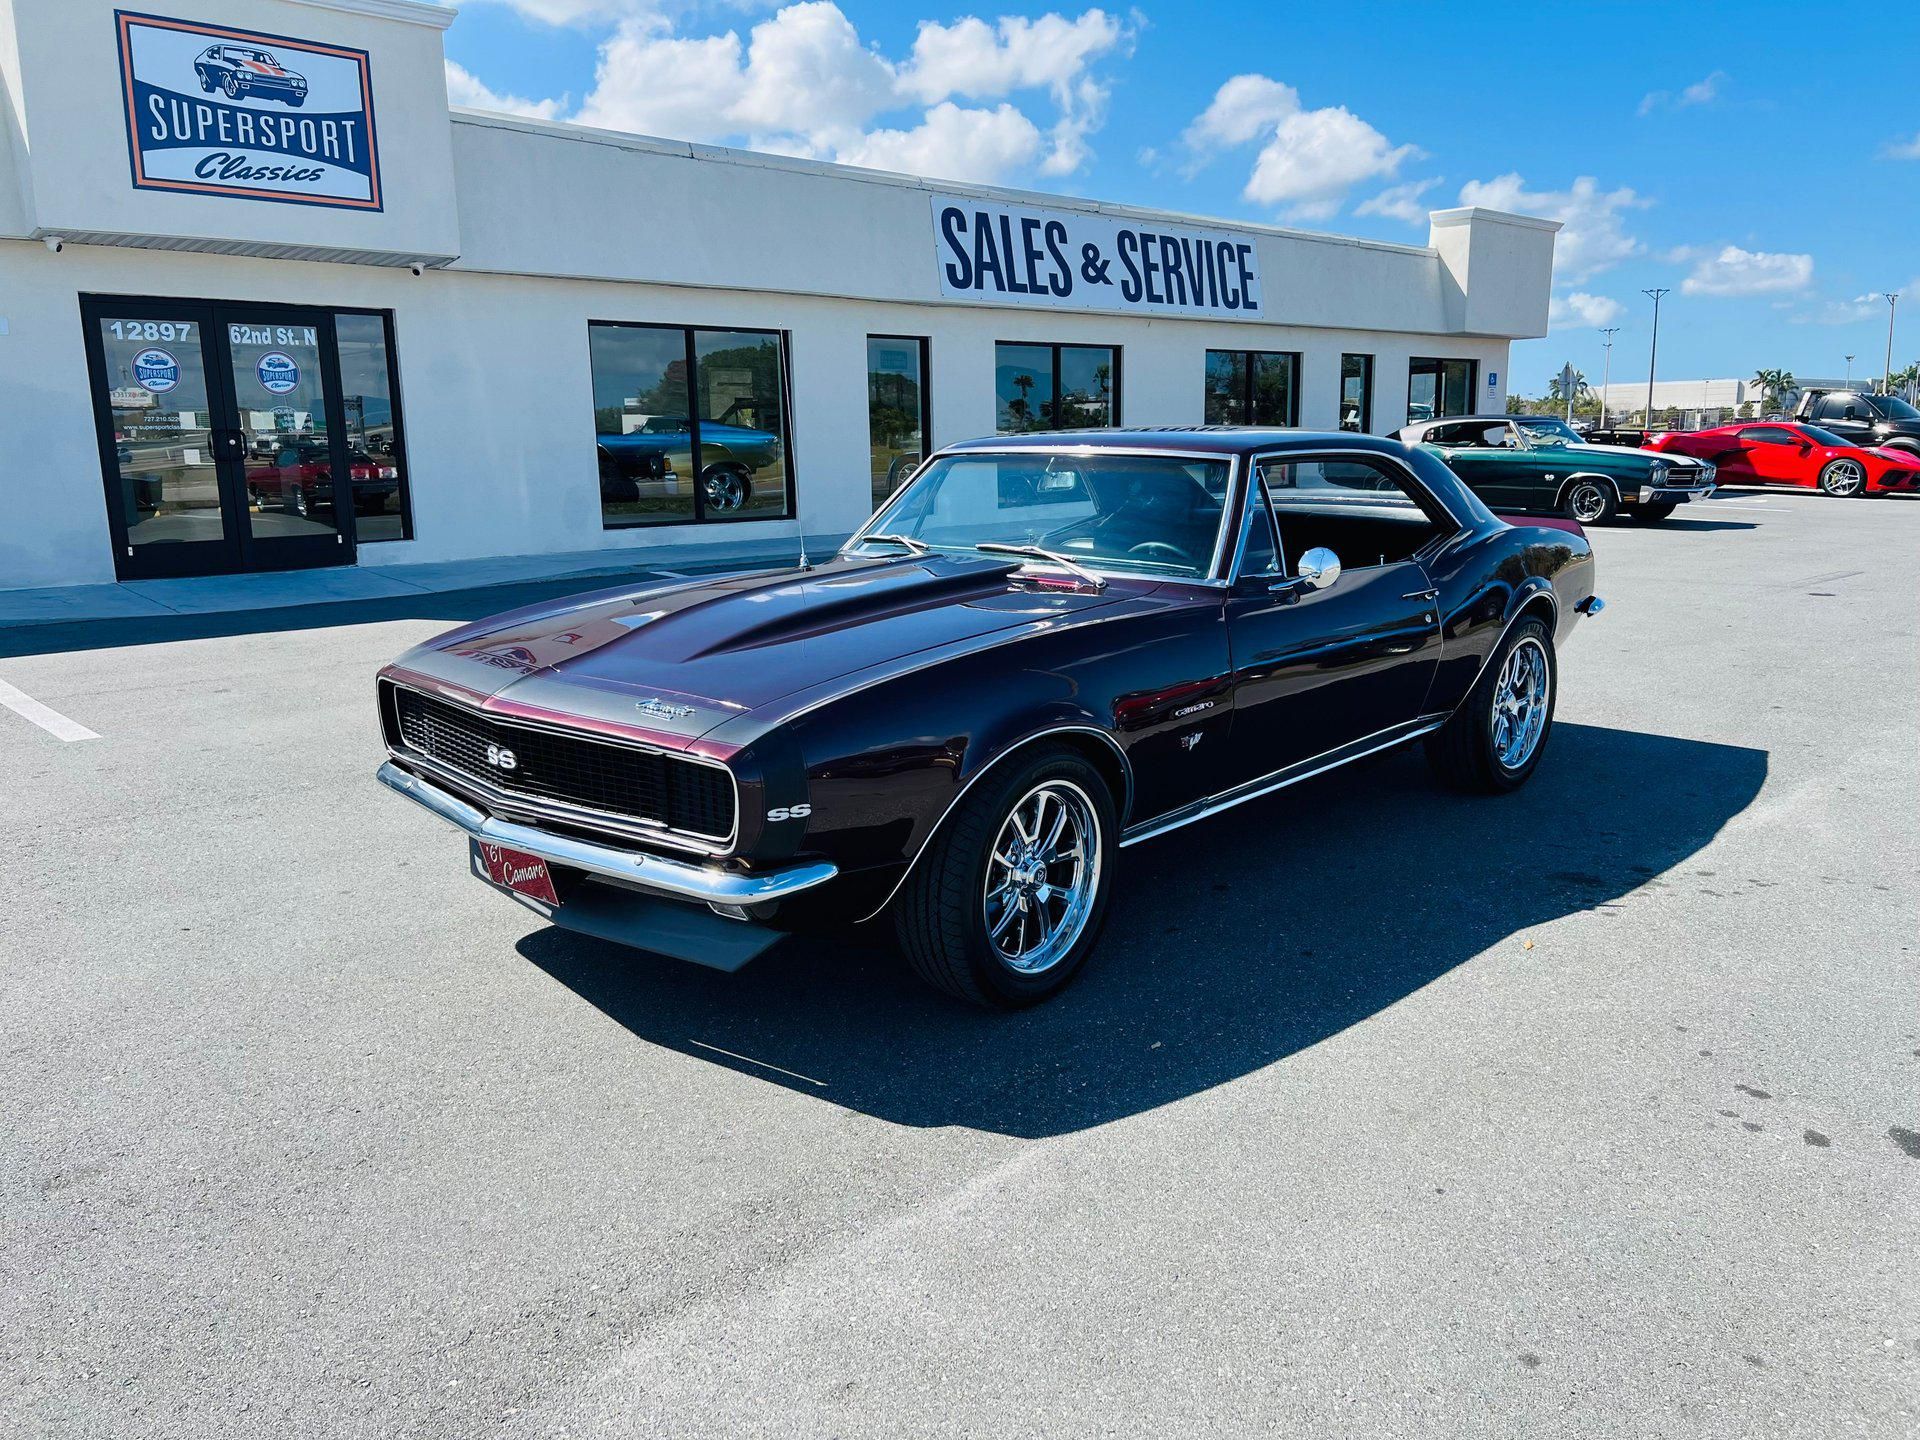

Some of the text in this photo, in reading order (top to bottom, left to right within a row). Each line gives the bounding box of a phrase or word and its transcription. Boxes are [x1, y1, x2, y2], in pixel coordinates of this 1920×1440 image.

[149, 94, 355, 163] SUPERSPORT
[194, 152, 326, 182] Classics
[941, 207, 1258, 310] SALES & SERVICE
[110, 321, 191, 342] 12897
[230, 326, 316, 346] 62nd St. N
[139, 367, 175, 379] SUPERSPORT
[262, 370, 295, 382] SUPERSPORT
[1175, 701, 1214, 717] camaro
[488, 744, 516, 769] SS
[767, 803, 812, 822] SS
[503, 861, 545, 885] Camaro
